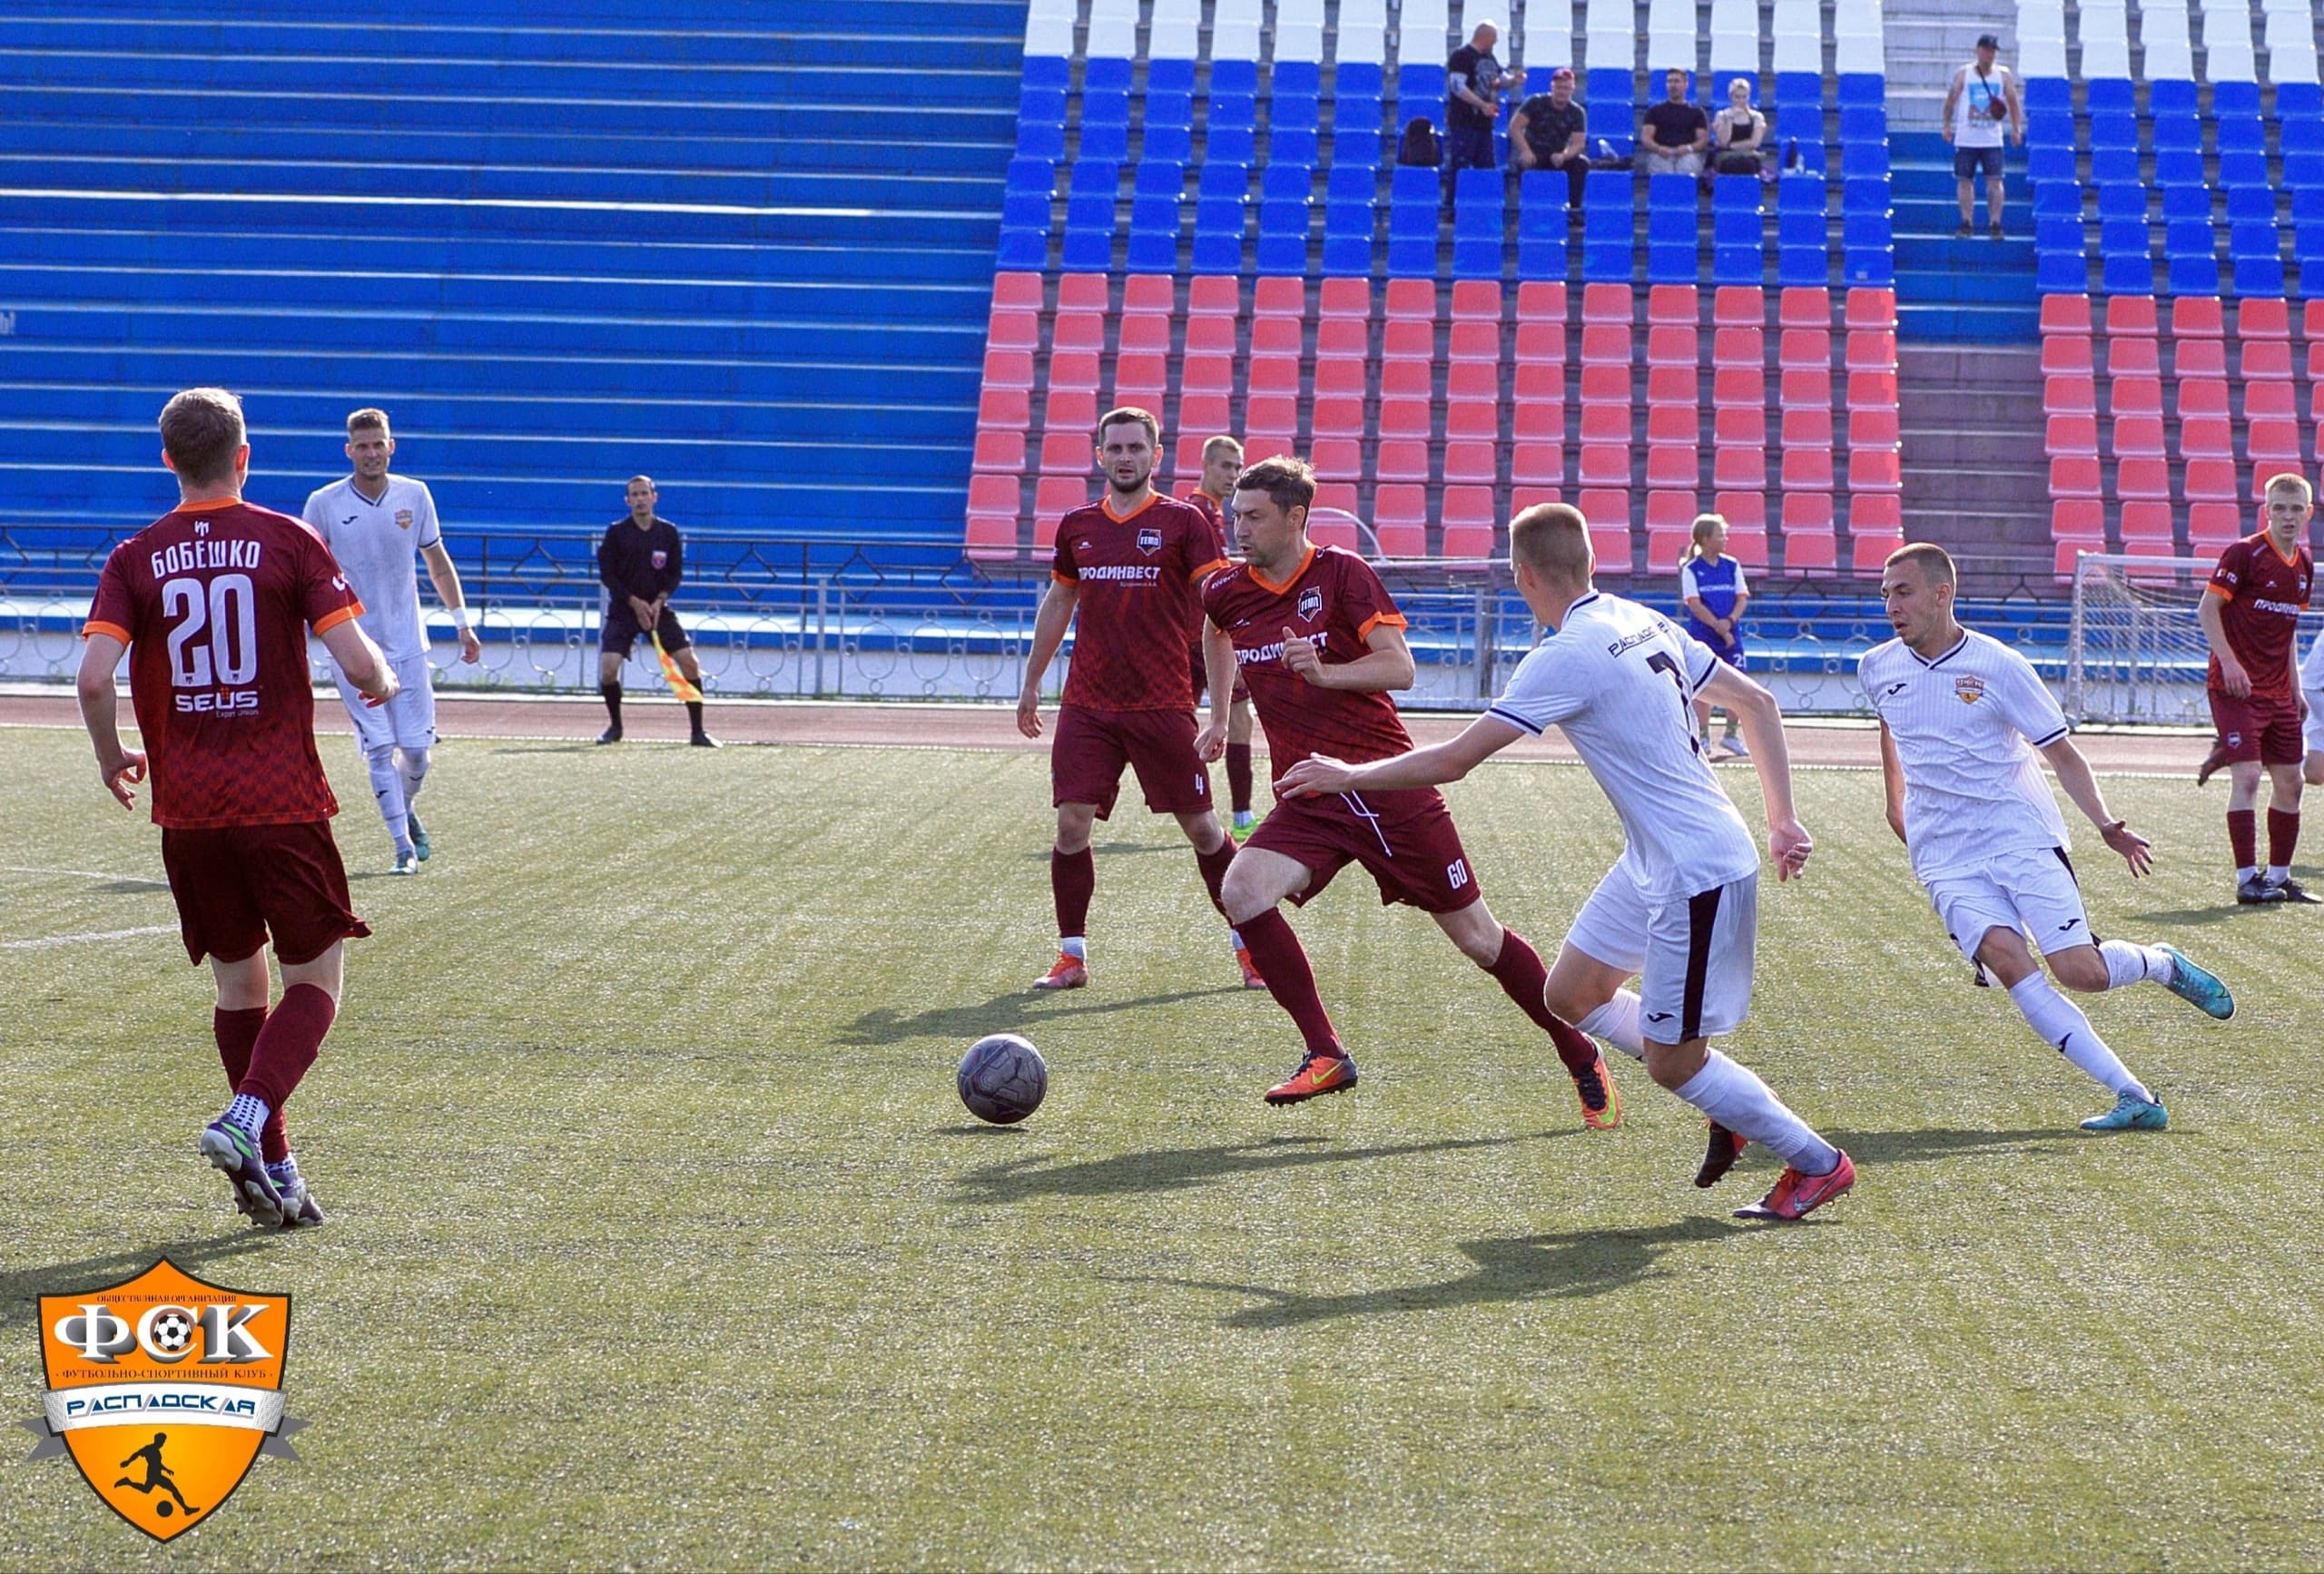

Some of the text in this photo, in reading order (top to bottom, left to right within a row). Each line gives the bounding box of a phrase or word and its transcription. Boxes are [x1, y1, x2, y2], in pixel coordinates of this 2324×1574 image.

[151, 539, 261, 579] БОБЕШКО
[162, 574, 258, 687] 20
[1235, 632, 1328, 664] ПРОДИСТ
[175, 691, 259, 712] SEUS
[1195, 773, 1204, 795] 4
[1447, 858, 1468, 890] 60
